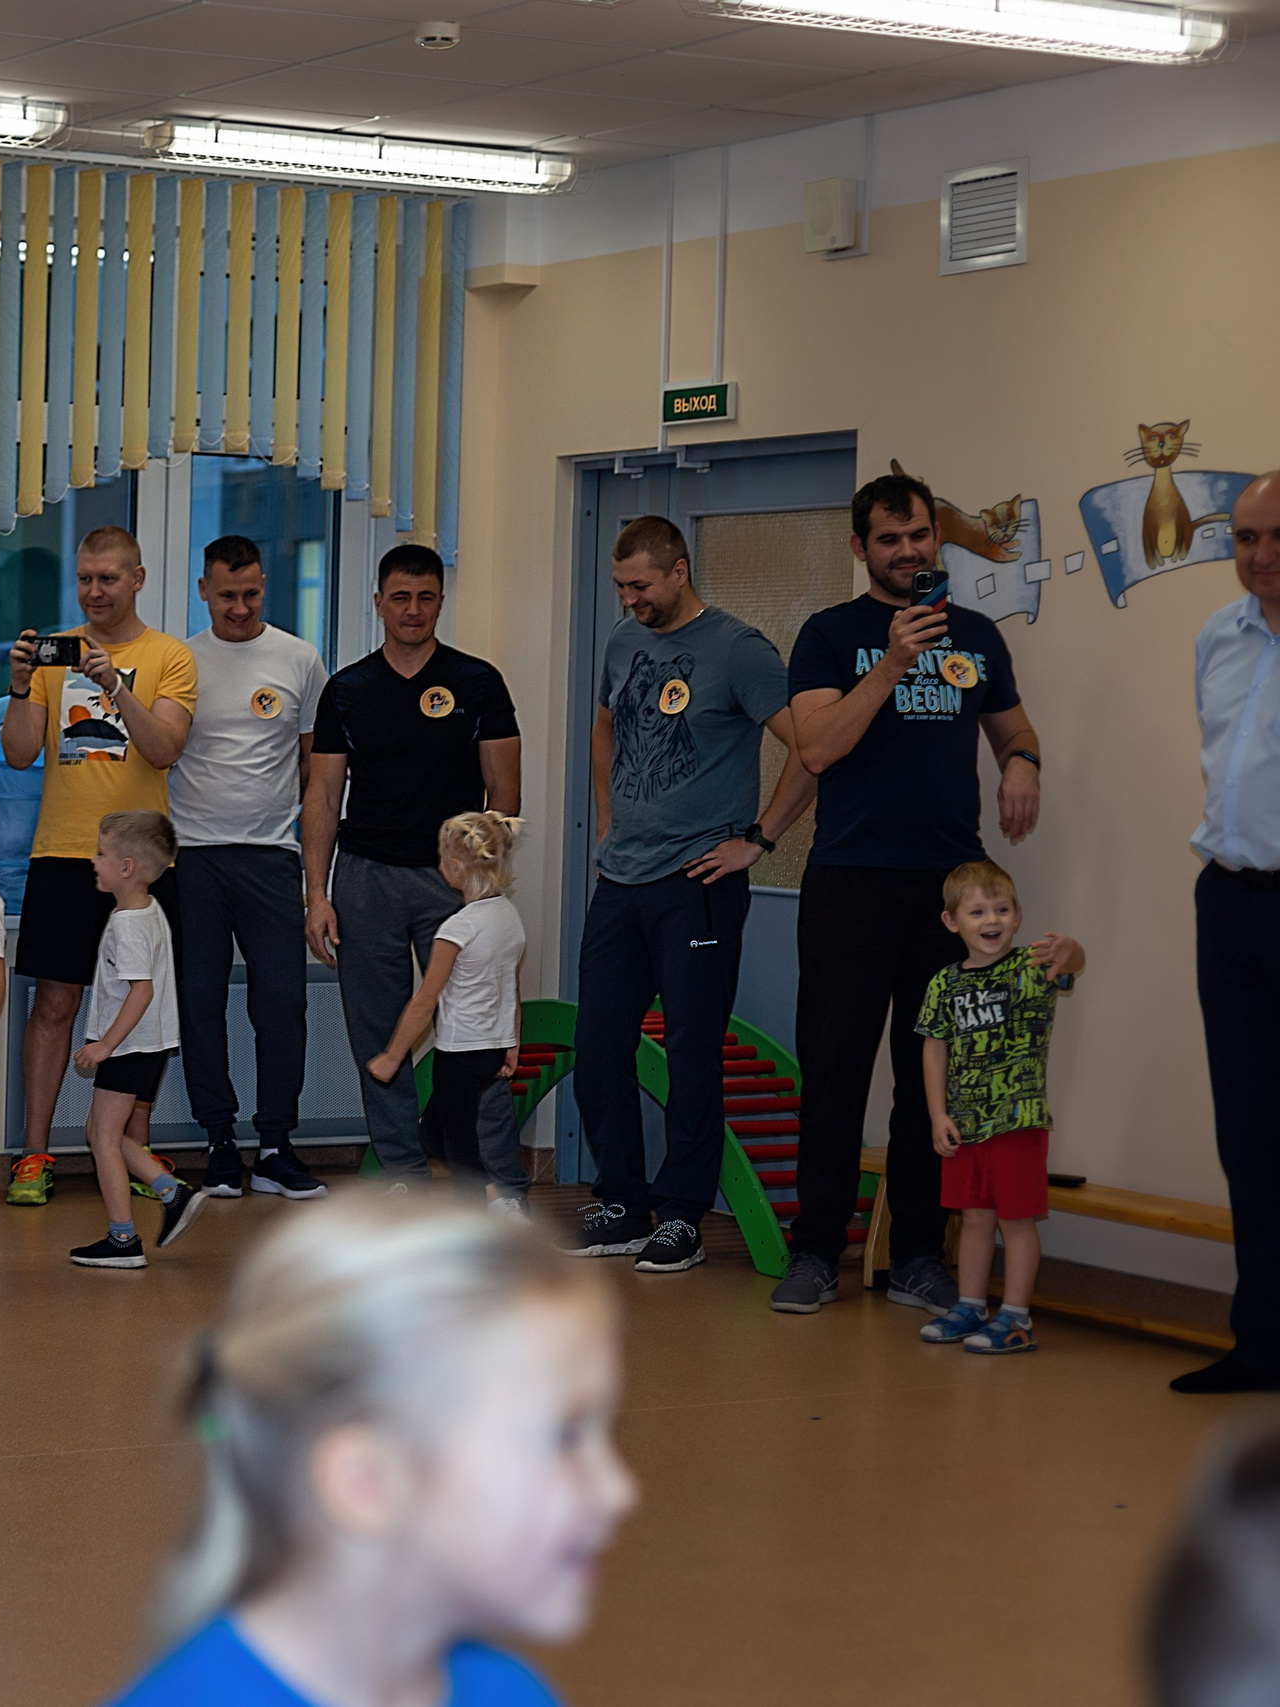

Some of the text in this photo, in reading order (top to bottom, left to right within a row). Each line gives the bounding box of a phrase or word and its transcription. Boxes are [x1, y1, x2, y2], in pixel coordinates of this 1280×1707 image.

[673, 394, 717, 413] ВЫХОД
[855, 648, 987, 682] ADNTE
[895, 685, 962, 714] BEGIN
[954, 1004, 1005, 1032] GAME
